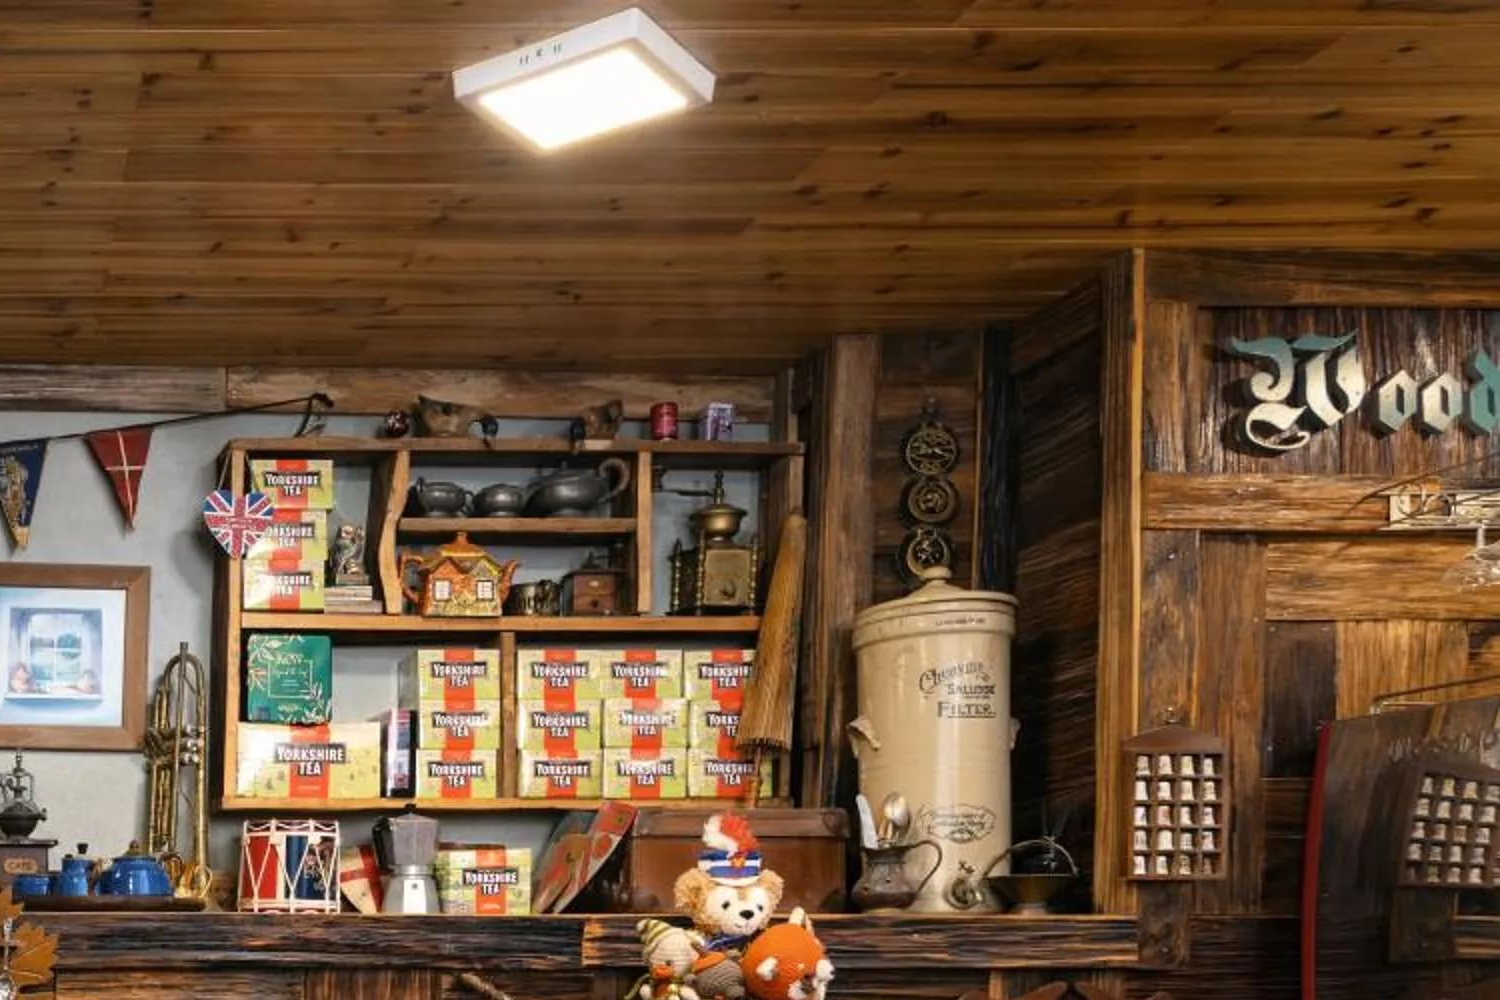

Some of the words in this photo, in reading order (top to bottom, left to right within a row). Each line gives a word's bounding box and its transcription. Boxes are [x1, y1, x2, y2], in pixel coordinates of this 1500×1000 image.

[266, 474, 319, 485] YORKSHIRE
[284, 486, 301, 495] TEA
[265, 525, 313, 537] ORKSHIRE
[433, 665, 485, 676] YORKSHIRE
[534, 665, 587, 676] YORKSHIRE
[701, 666, 751, 677] YORKSHIR
[451, 677, 468, 686] TEA
[552, 677, 569, 687] TEA
[632, 678, 650, 687] TEA
[719, 678, 737, 687] TEA
[534, 715, 587, 726] YORKSHIRE
[709, 714, 740, 725] YORKS
[452, 727, 468, 737] TEA
[552, 727, 569, 737] TEA
[638, 726, 657, 735] TEA
[727, 726, 737, 736] TE
[277, 748, 344, 761] YORKSHIRE
[299, 763, 321, 774] TEA
[431, 765, 483, 775] YORKSHIRE
[537, 765, 588, 775] YORKSHIRE
[620, 764, 673, 774] YORKSHIRE
[448, 776, 465, 785] TEA
[554, 776, 571, 785] TEA
[637, 776, 654, 785] TEA
[724, 775, 741, 784] TEA
[465, 872, 517, 884] YORKSHIRE
[483, 884, 500, 894] TEA
